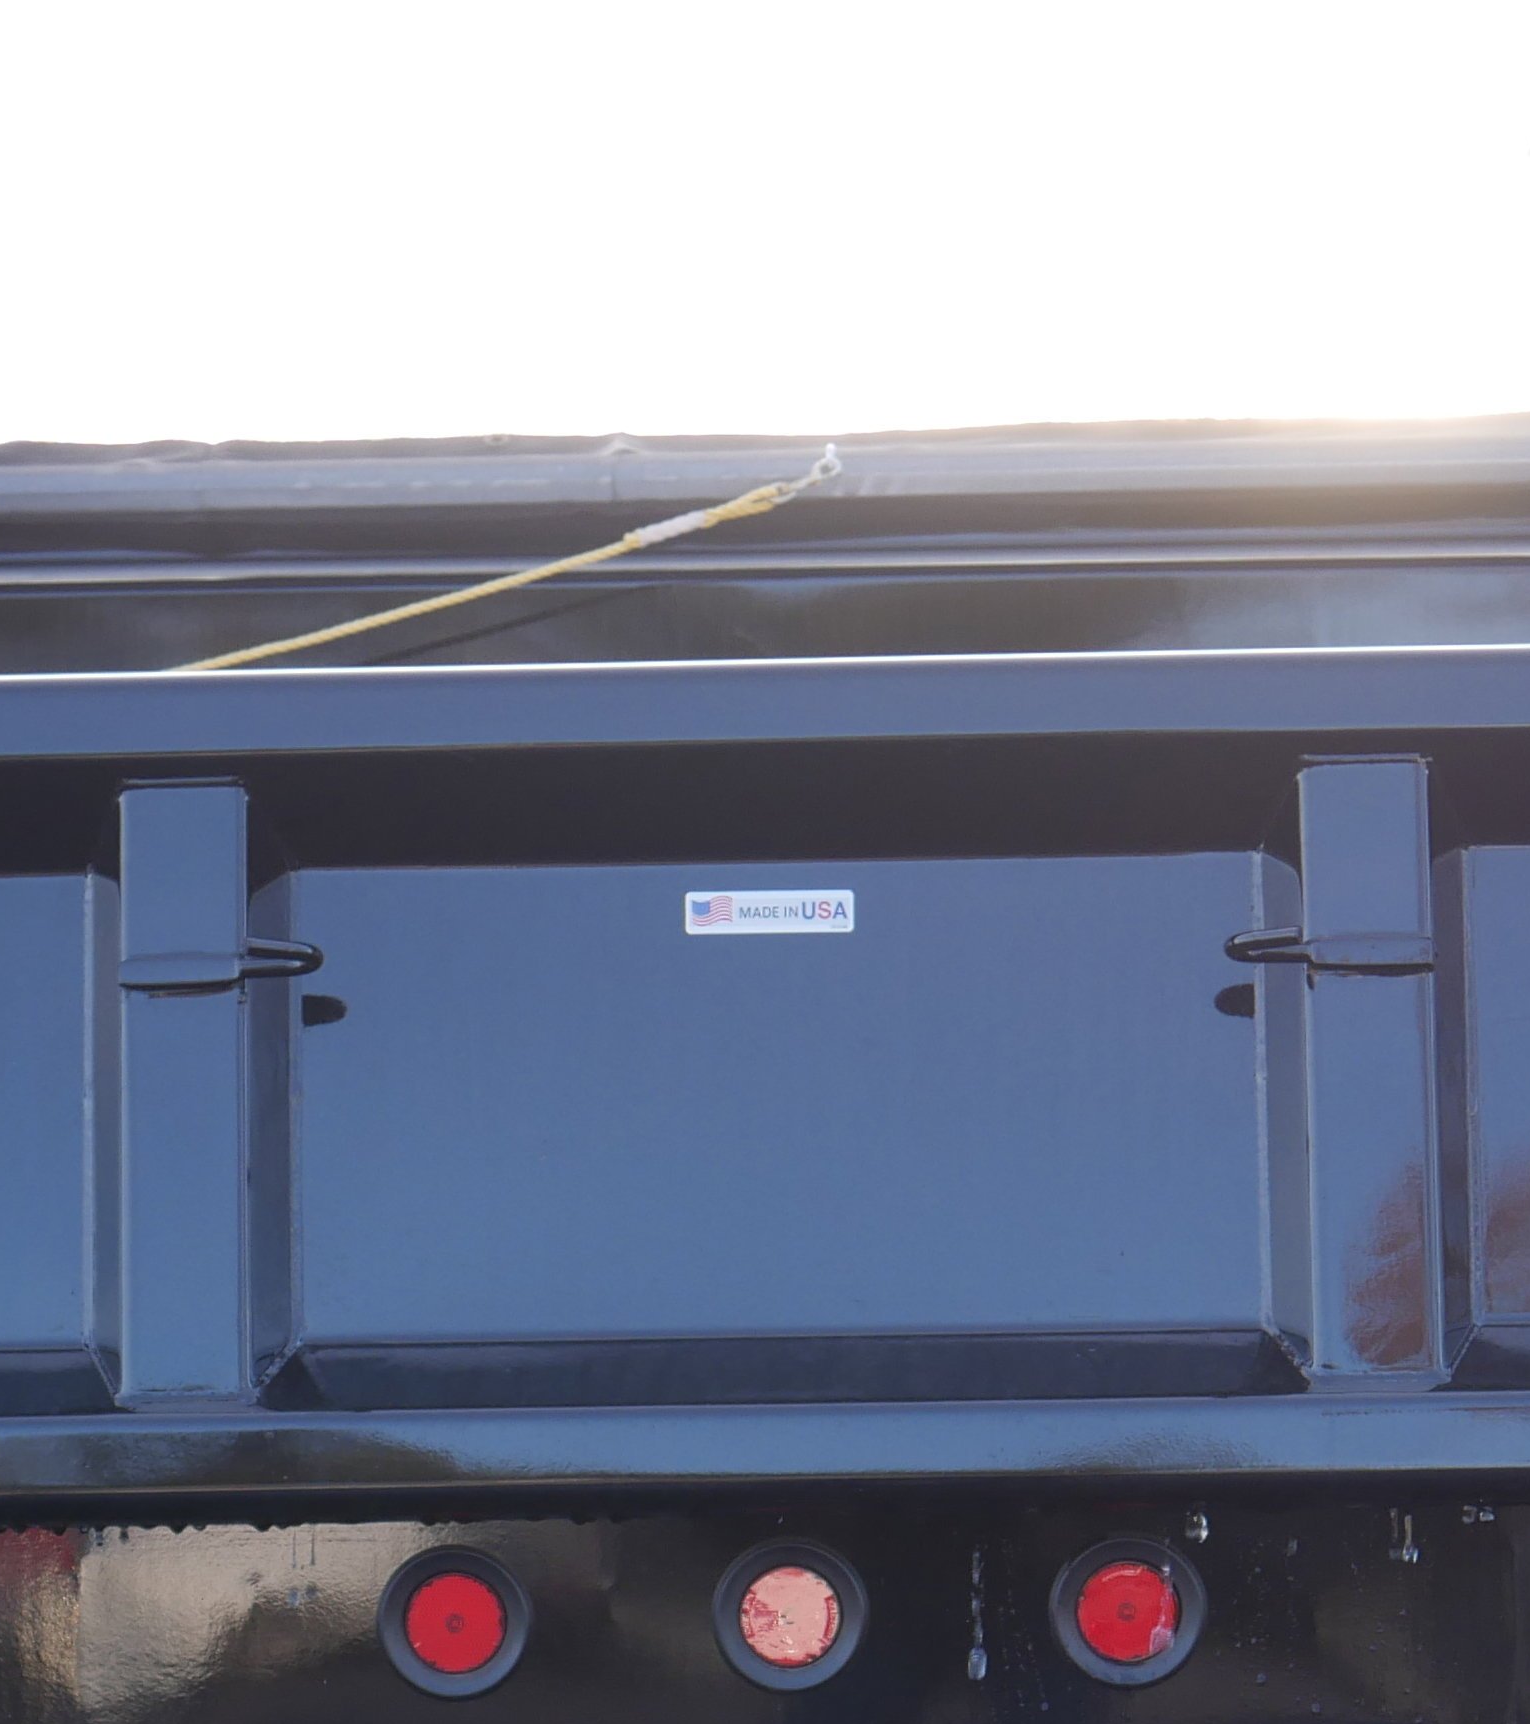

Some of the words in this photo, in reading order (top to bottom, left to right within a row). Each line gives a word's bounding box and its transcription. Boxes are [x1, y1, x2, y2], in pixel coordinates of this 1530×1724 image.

[739, 906, 780, 919] MADE
[784, 905, 799, 919] IN
[801, 900, 848, 920] USA
